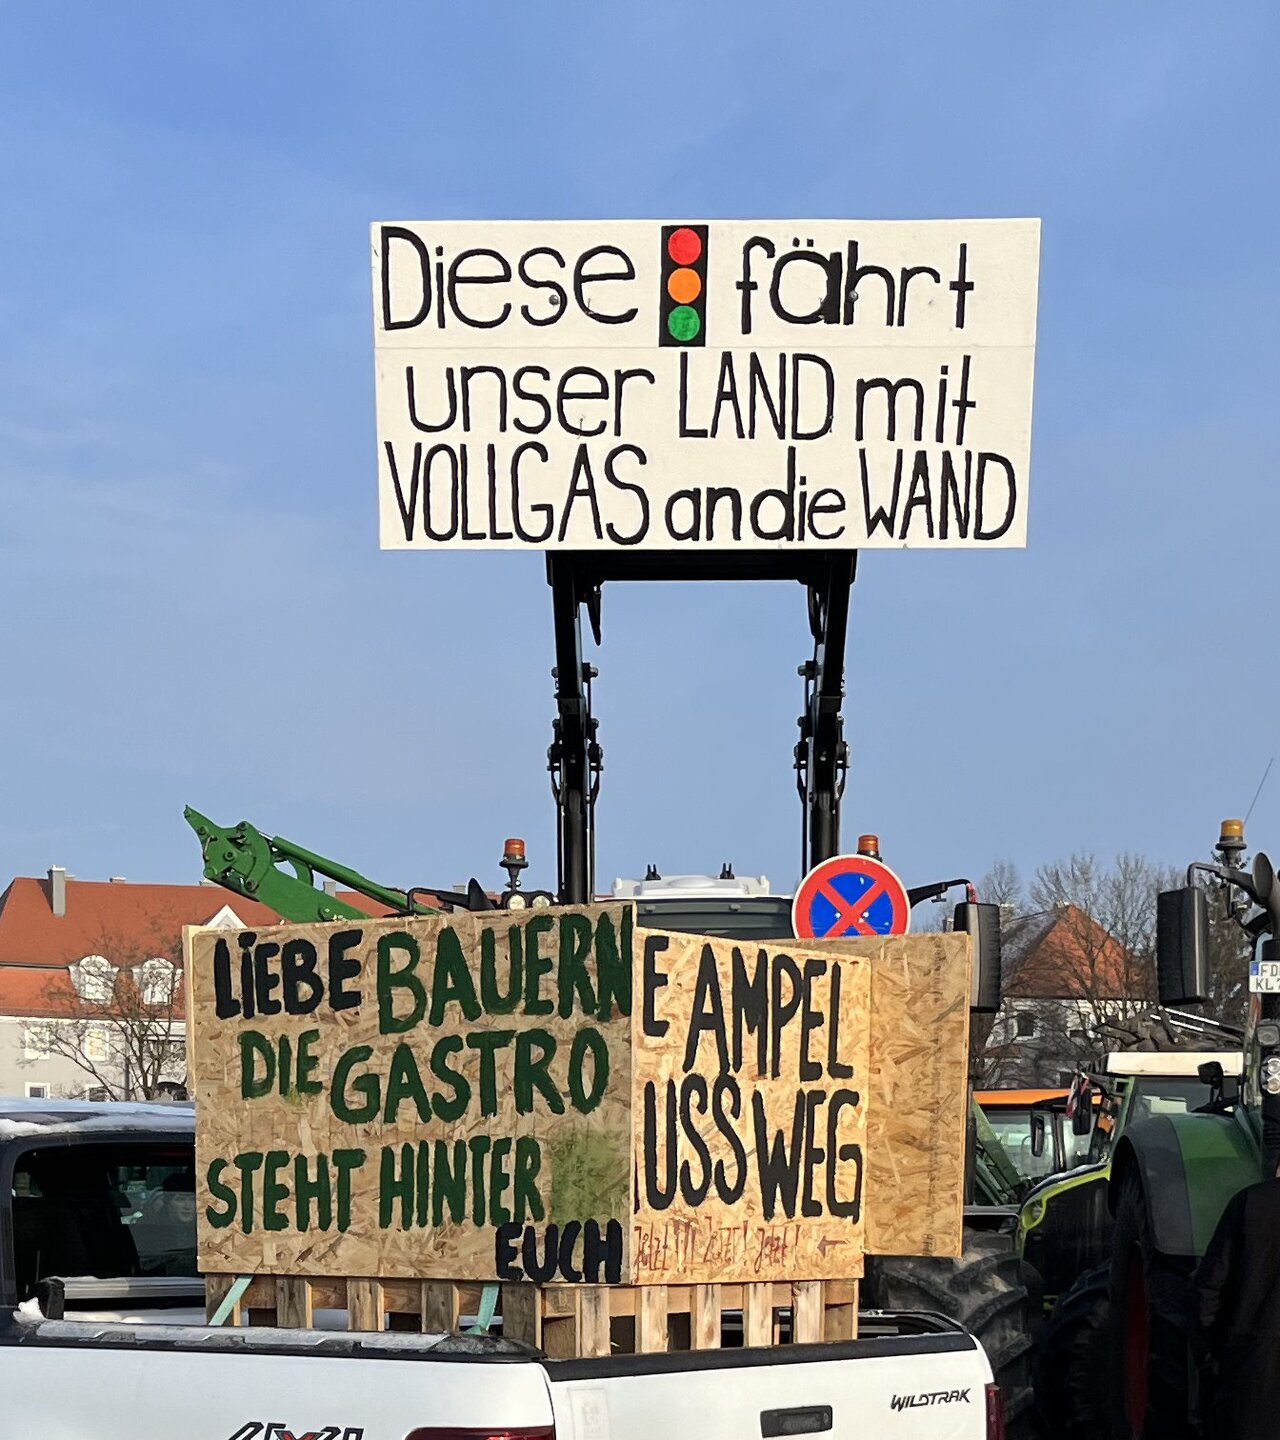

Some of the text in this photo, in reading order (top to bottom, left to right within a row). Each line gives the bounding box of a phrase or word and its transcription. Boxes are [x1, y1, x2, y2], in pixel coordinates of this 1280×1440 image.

[381, 225, 974, 334] Diese fährt
[405, 351, 976, 445] unser LAND mit
[385, 441, 649, 545] VOLLGAS
[858, 449, 1017, 541] WAND
[376, 905, 634, 1034] BAUERN
[682, 942, 854, 1082] AMPEL
[1255, 978, 1274, 991] KL
[238, 1027, 611, 1124] DIE GASTRO
[205, 1136, 546, 1234] STEHT HINTER
[634, 1072, 863, 1223] USS WEG
[495, 1217, 623, 1284] EUCH
[890, 1387, 972, 1413] WILDTRAK
